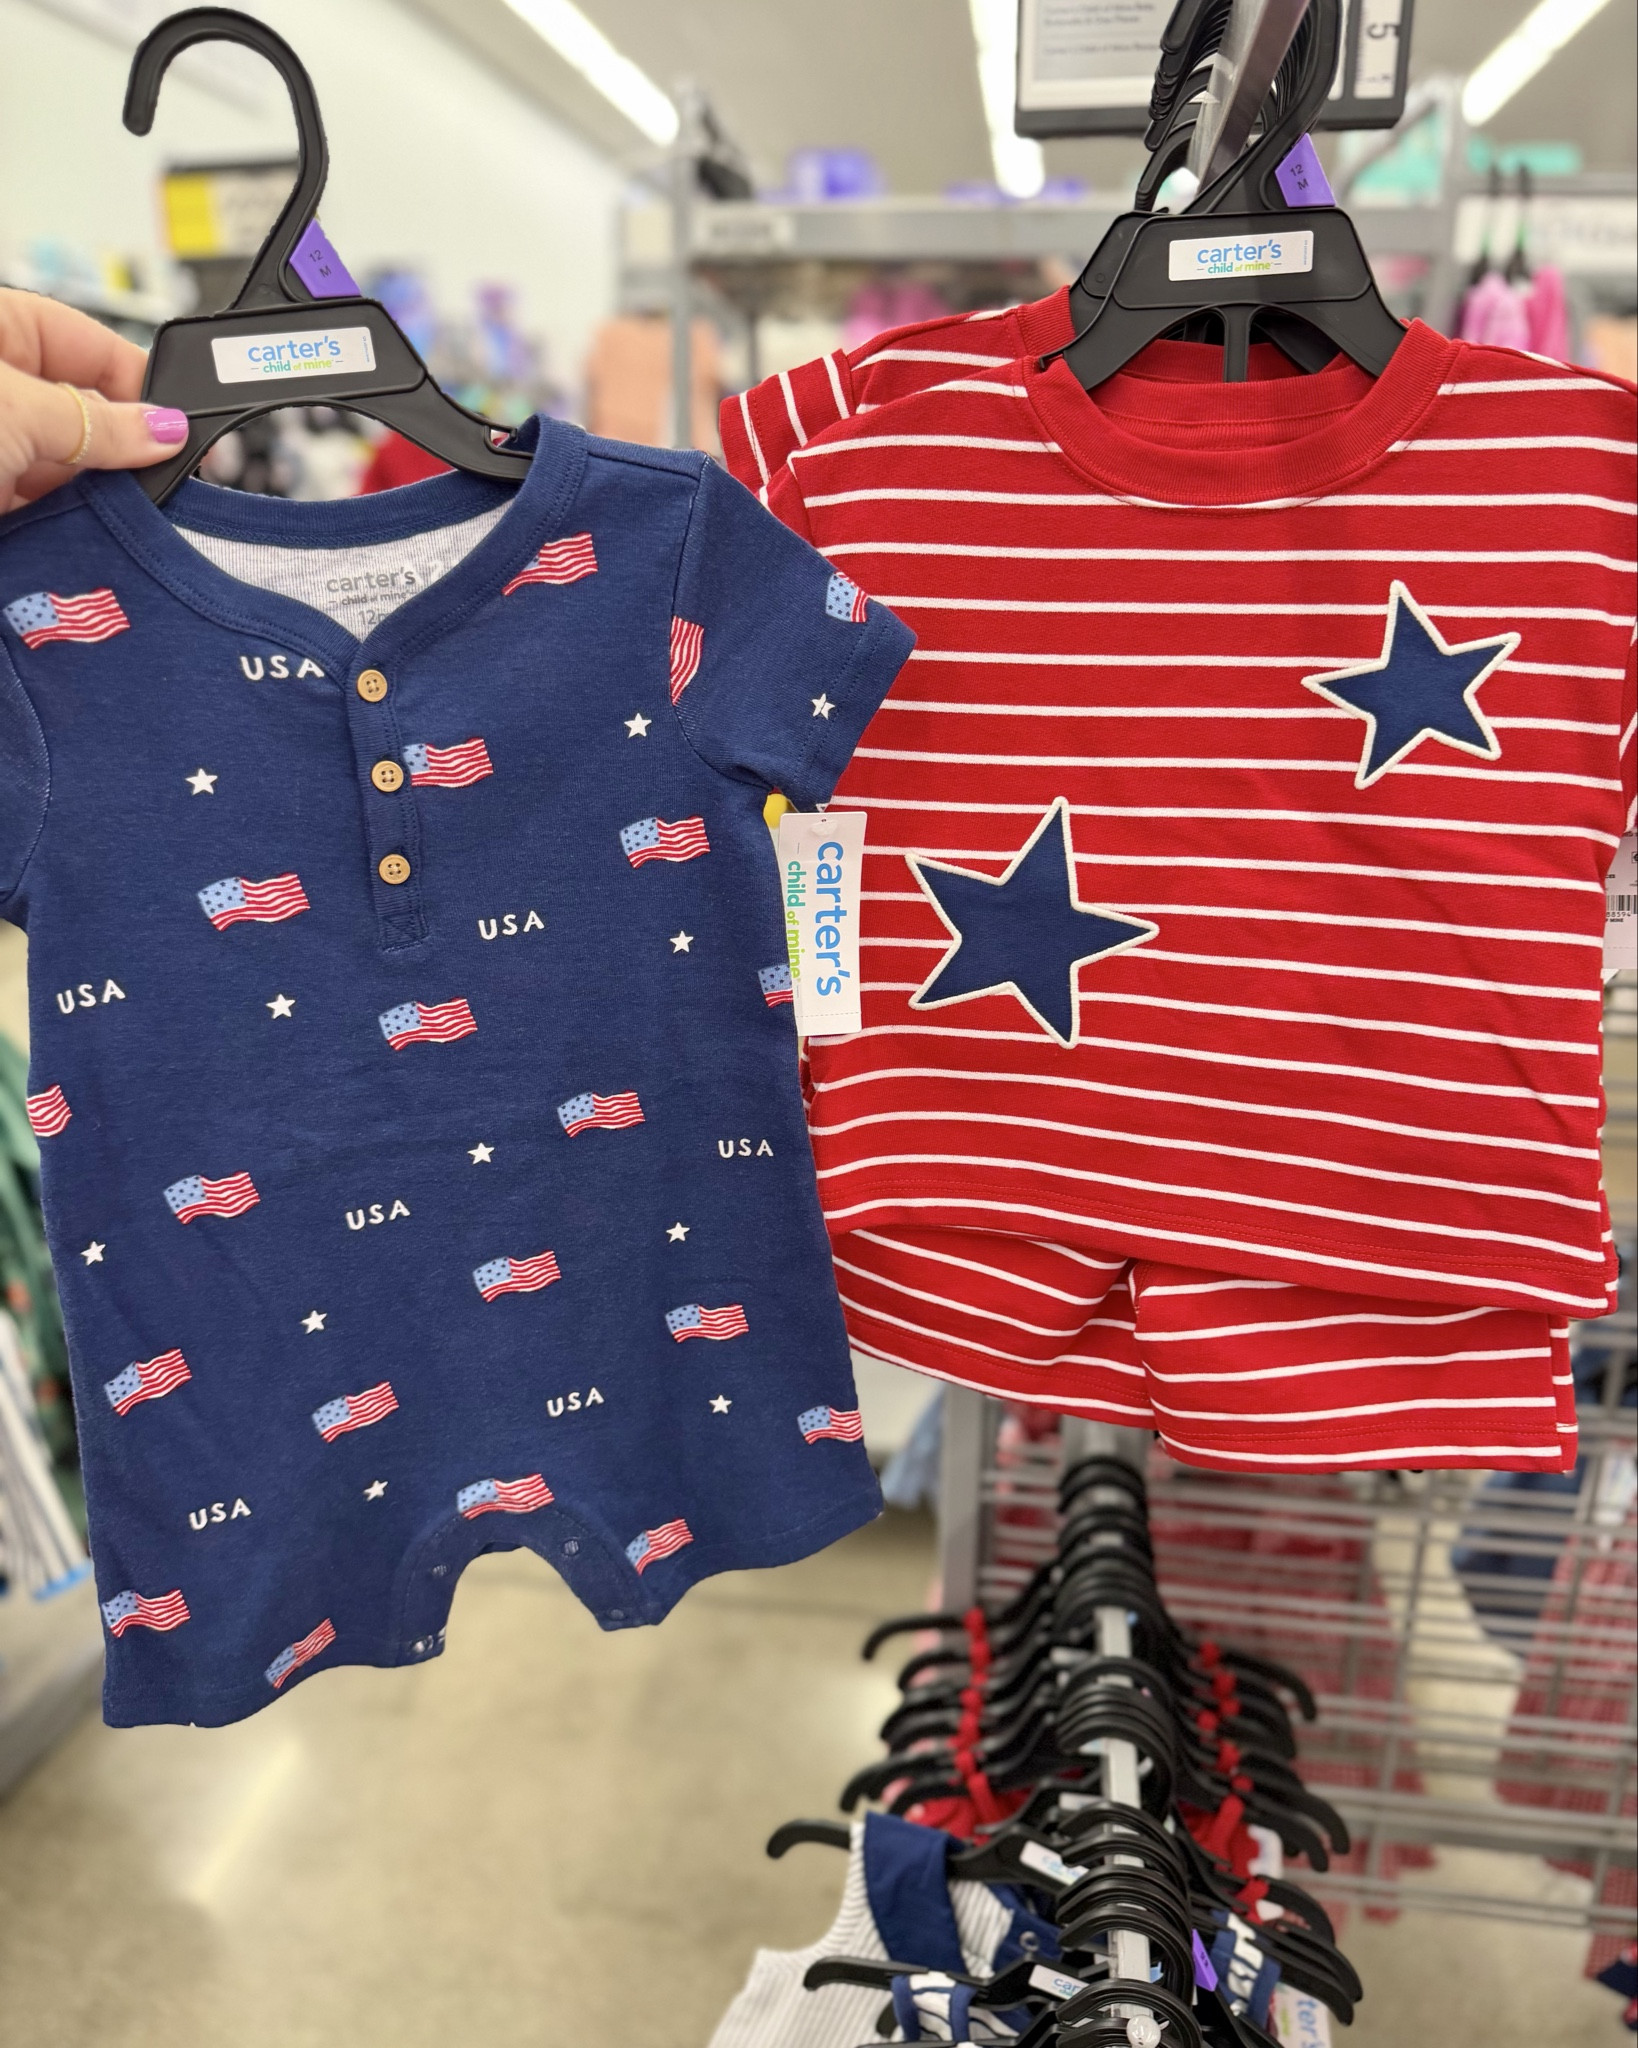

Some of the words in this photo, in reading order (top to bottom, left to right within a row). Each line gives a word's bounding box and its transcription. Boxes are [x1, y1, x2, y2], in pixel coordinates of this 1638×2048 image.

[1290, 164, 1304, 176] 12
[1297, 178, 1309, 190] M
[309, 249, 324, 262] 12
[1197, 239, 1282, 264] carter's
[319, 265, 332, 277] M
[1207, 262, 1233, 274] child
[1234, 264, 1243, 272] of
[1244, 260, 1271, 271] mine
[247, 335, 341, 363] carter's
[263, 360, 291, 373] child
[293, 362, 302, 370] of
[303, 358, 332, 370] mine
[326, 566, 416, 593] carter's
[341, 594, 367, 606] child
[379, 590, 407, 602] mine
[241, 655, 324, 681] USA
[787, 860, 807, 908] child
[479, 911, 544, 940] USA
[786, 910, 800, 926] of
[815, 841, 850, 996] carter's
[786, 929, 805, 979] mine
[57, 979, 125, 1014] USA
[718, 1139, 774, 1159] USA
[346, 1200, 410, 1231] USA
[547, 1388, 604, 1417] USA
[190, 1499, 252, 1530] USA
